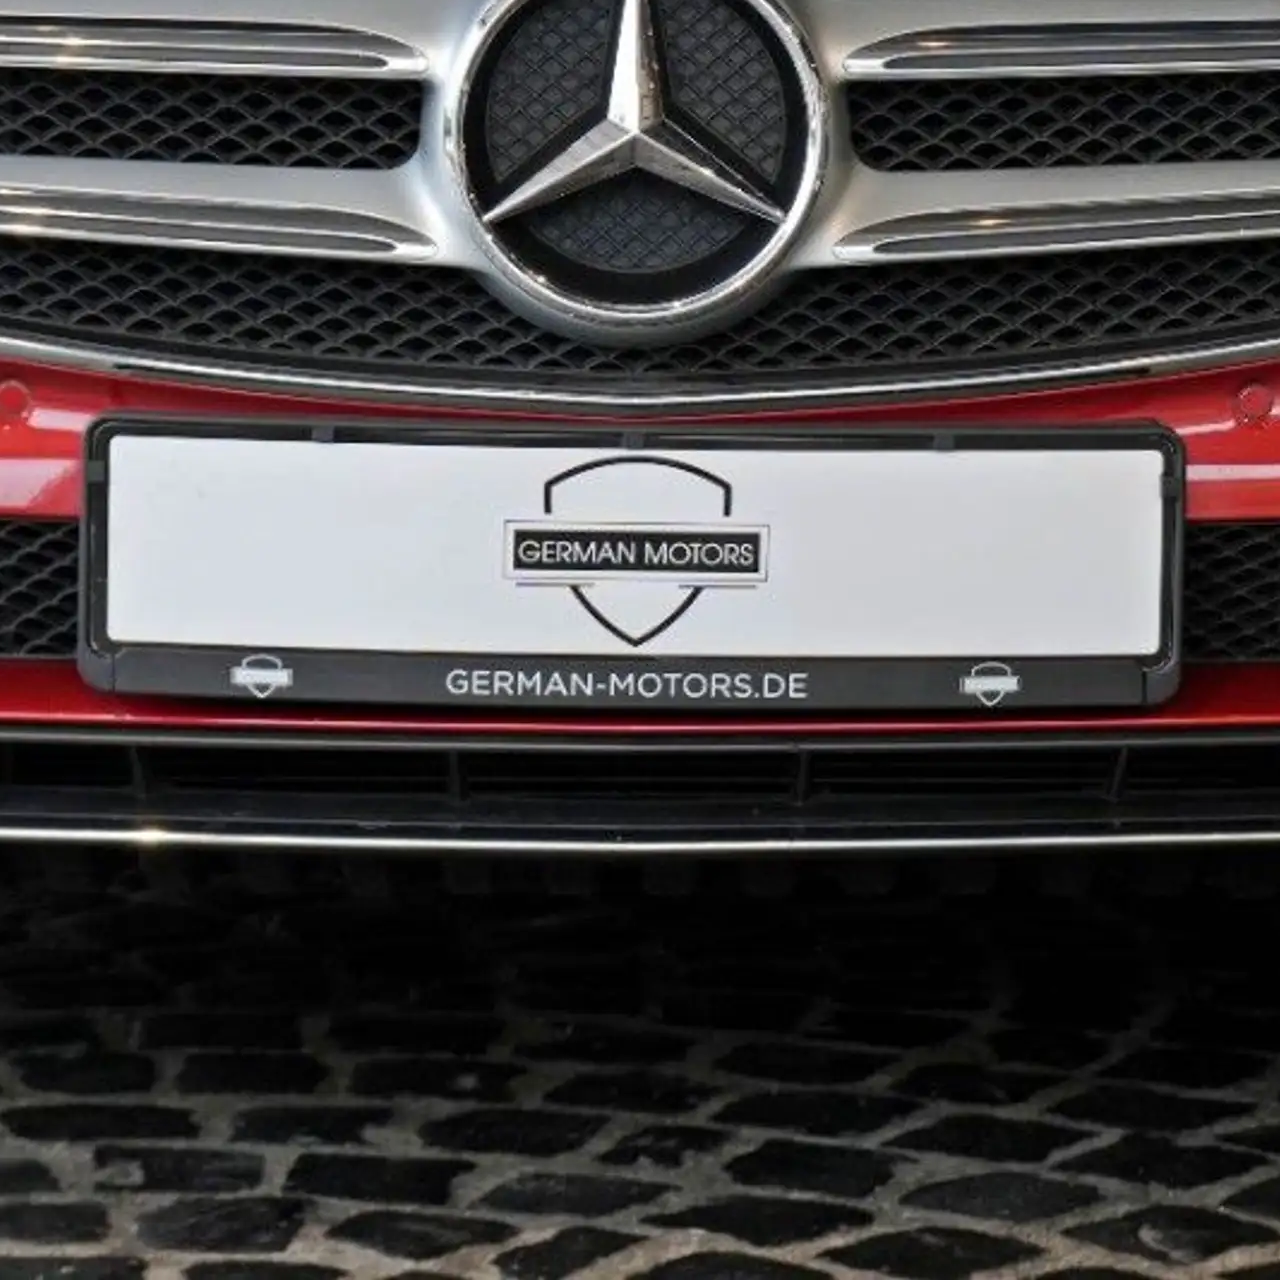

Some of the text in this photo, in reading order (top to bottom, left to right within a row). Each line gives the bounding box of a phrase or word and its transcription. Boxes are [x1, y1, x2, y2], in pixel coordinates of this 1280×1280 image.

[518, 539, 755, 566] GERMAN MOTORS
[445, 669, 809, 699] GERMAN-MOTORS.DE
